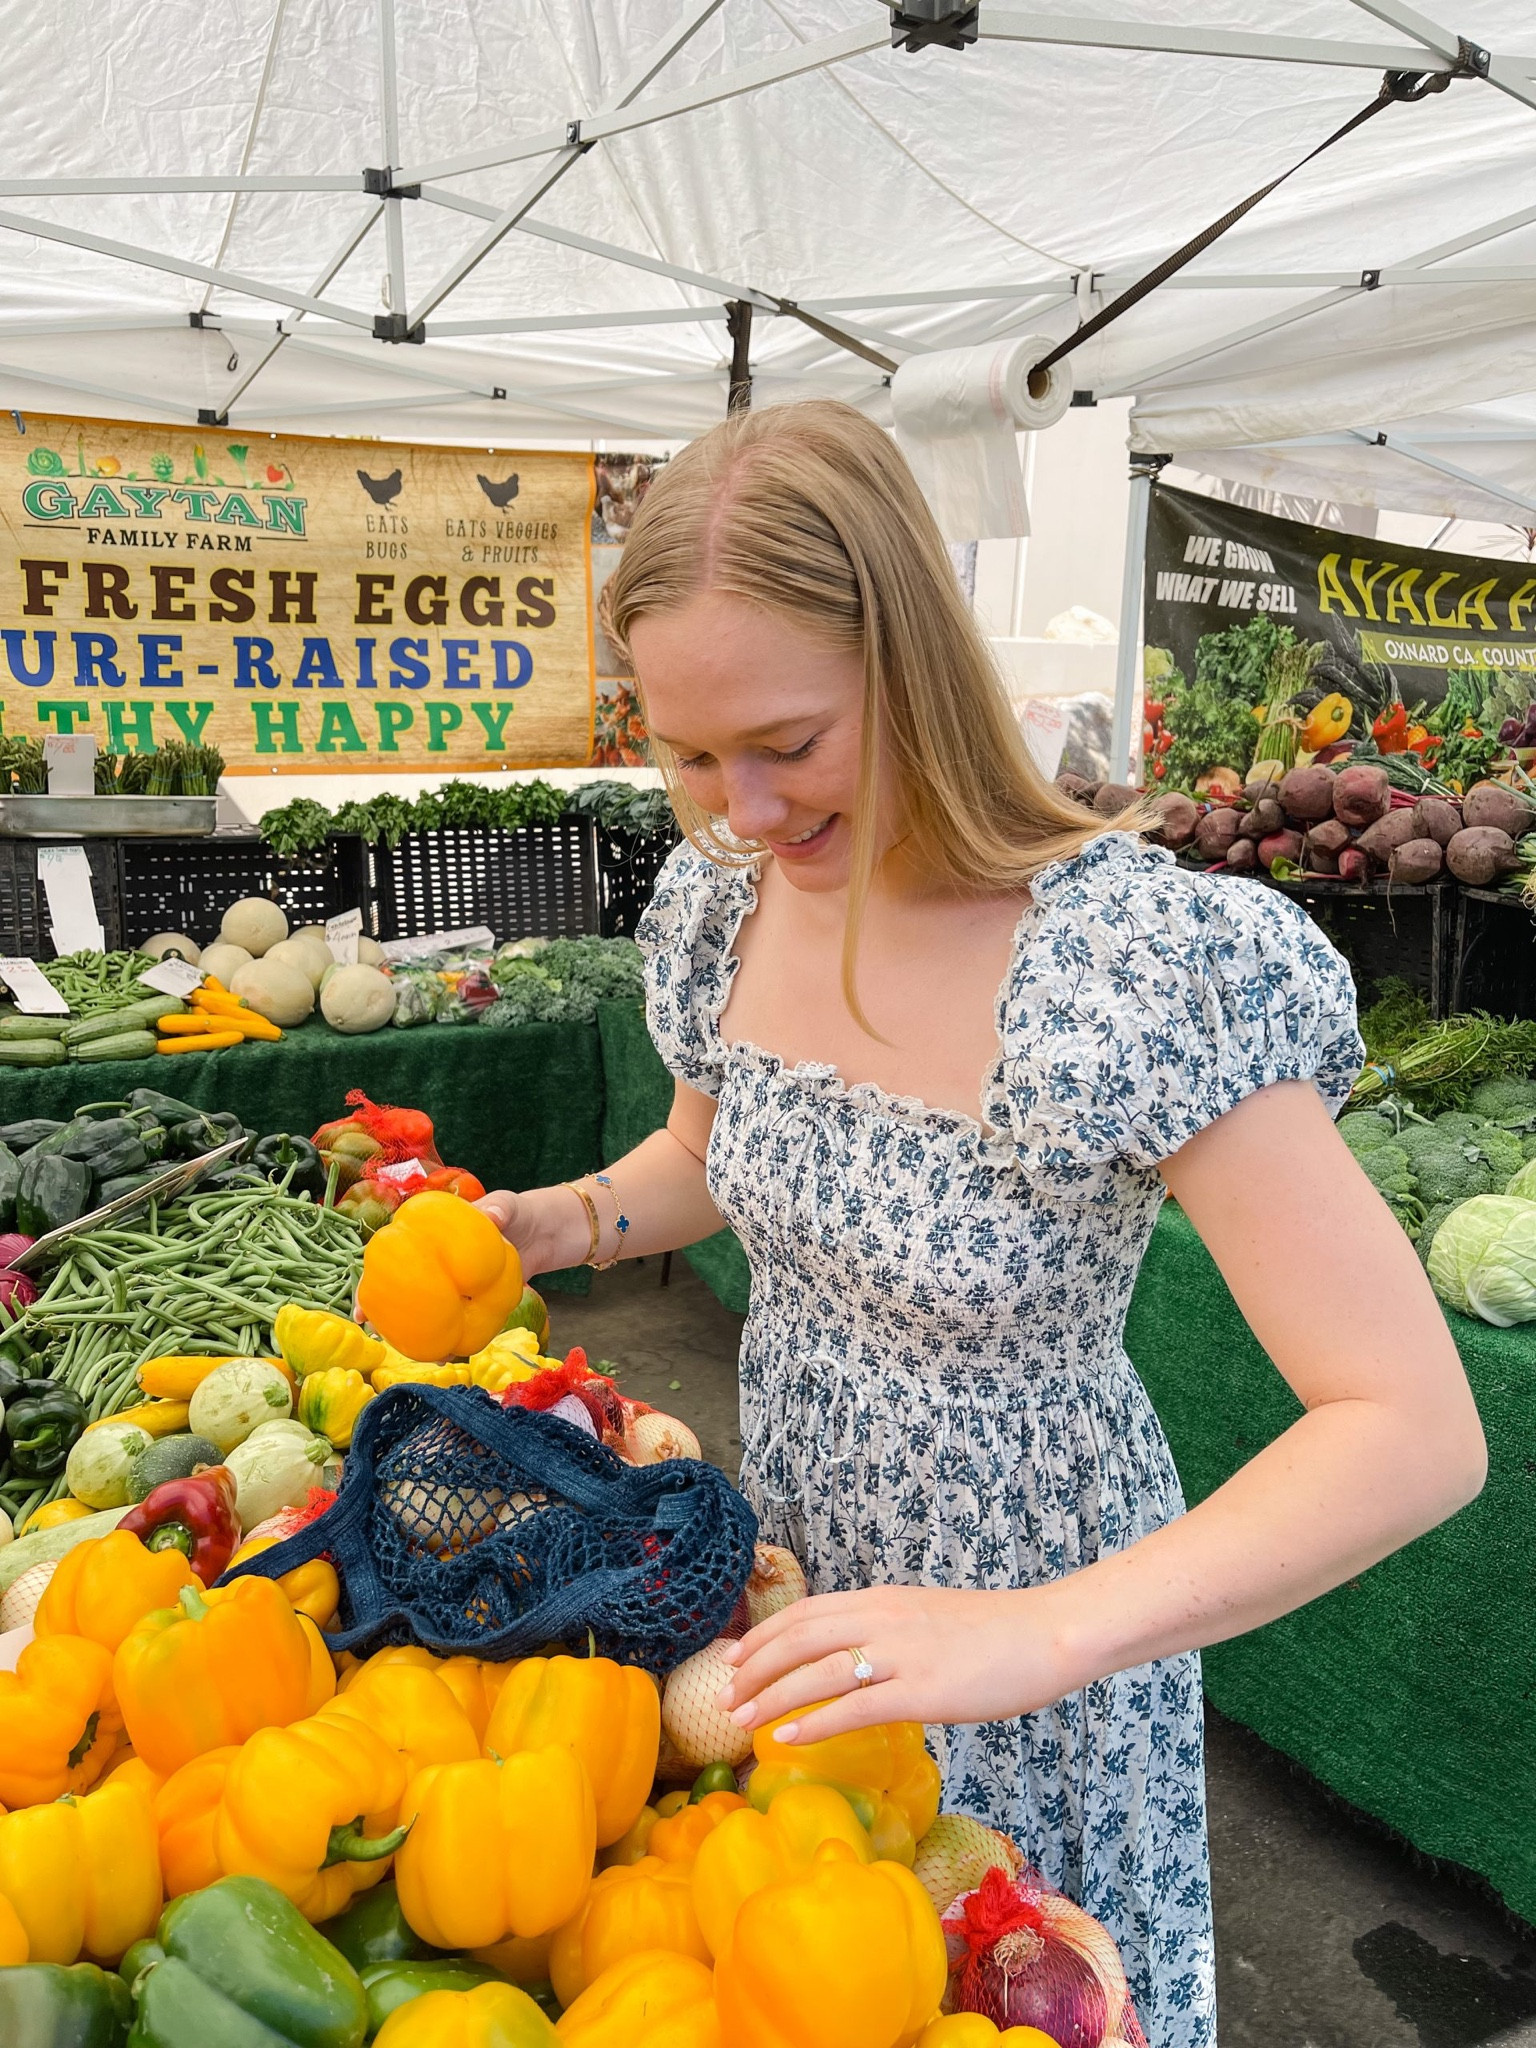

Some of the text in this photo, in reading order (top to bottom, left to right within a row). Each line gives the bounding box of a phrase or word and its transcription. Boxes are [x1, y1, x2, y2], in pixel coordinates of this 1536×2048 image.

[22, 479, 308, 536] GAYTAN
[365, 514, 409, 535] EATS
[86, 527, 253, 552] FAMILY FARM
[445, 518, 558, 540] EATS VEGGIES
[366, 541, 408, 560] BUGS
[461, 545, 539, 564] & FRUITS
[1183, 535, 1276, 574] WE GROW
[20, 559, 556, 628] FRESH EGGS
[1156, 571, 1298, 614] WHAT WE SELL
[1317, 552, 1536, 631] AYALA F
[0, 629, 534, 689] URE-RAISED
[1384, 639, 1449, 664] OXNARD
[1453, 645, 1479, 665] CA.
[0, 700, 514, 754] THY HAPPY
